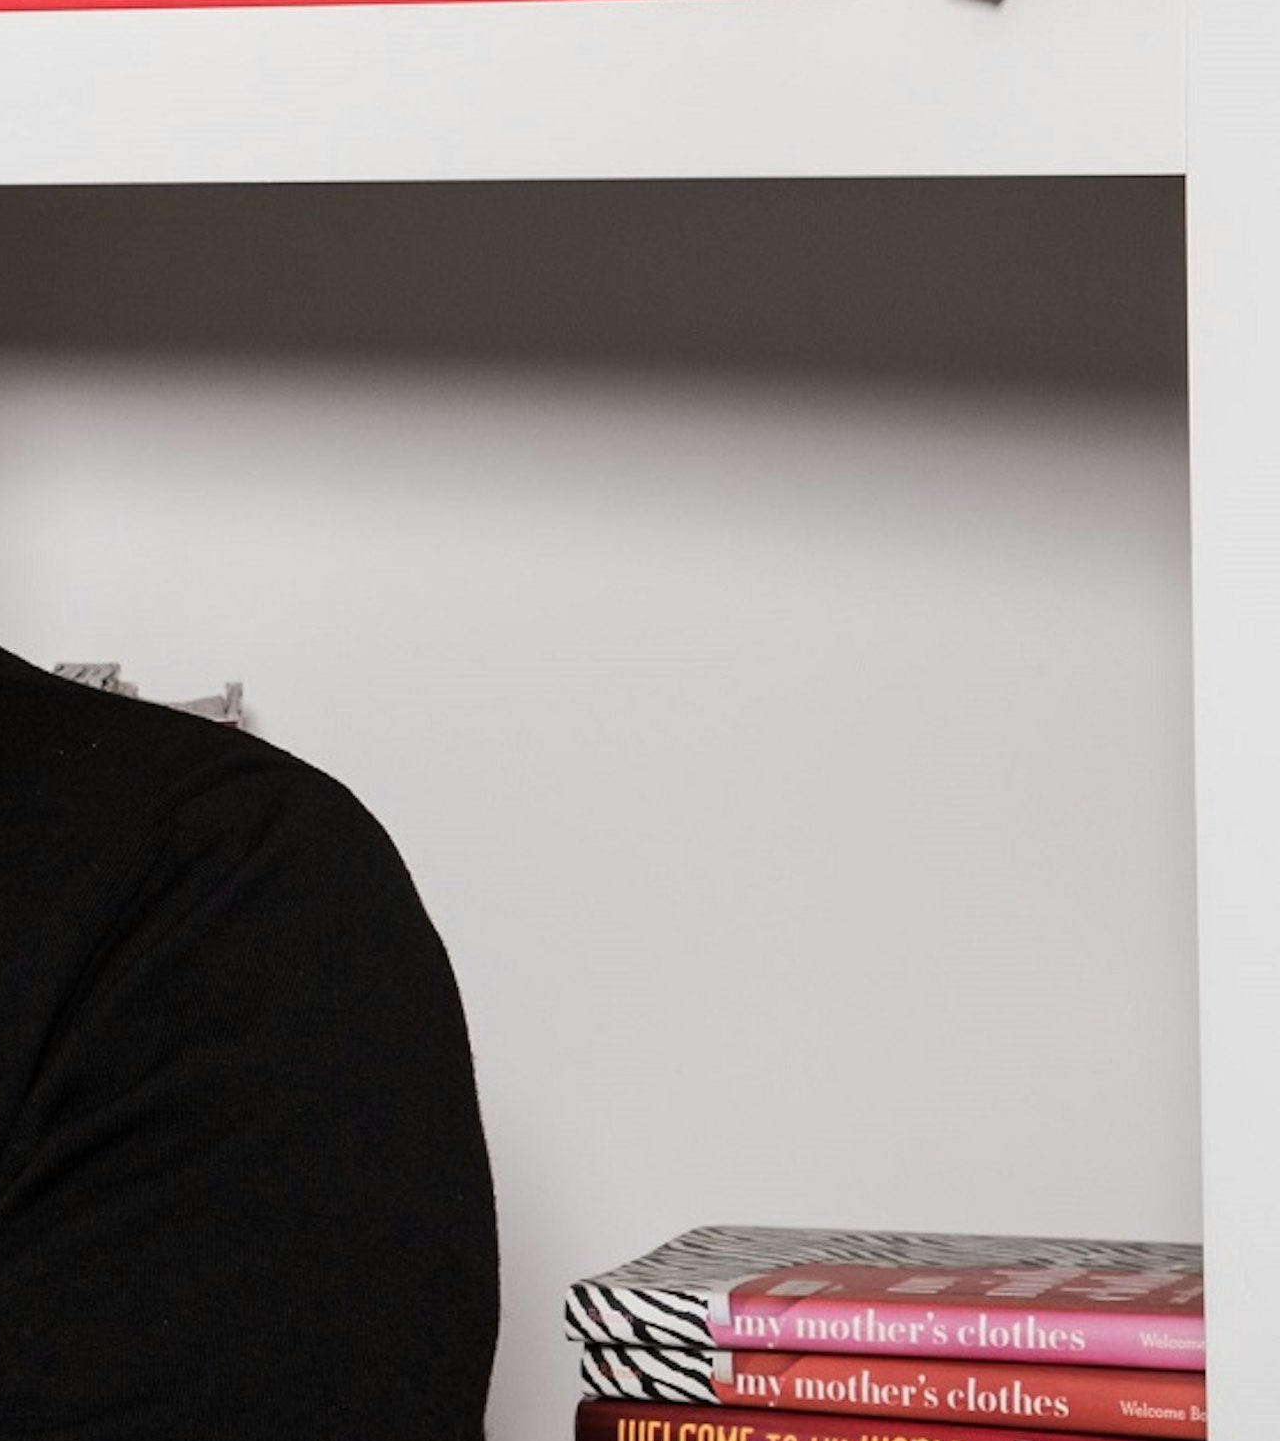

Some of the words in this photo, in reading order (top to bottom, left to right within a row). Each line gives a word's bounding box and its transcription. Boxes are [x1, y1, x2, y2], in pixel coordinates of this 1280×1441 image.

[734, 1314, 786, 1348] my
[795, 1309, 948, 1345] mother's
[957, 1314, 1086, 1351] clothes
[736, 1372, 786, 1407] my
[795, 1370, 939, 1408] mother's
[947, 1376, 1070, 1417] clothes
